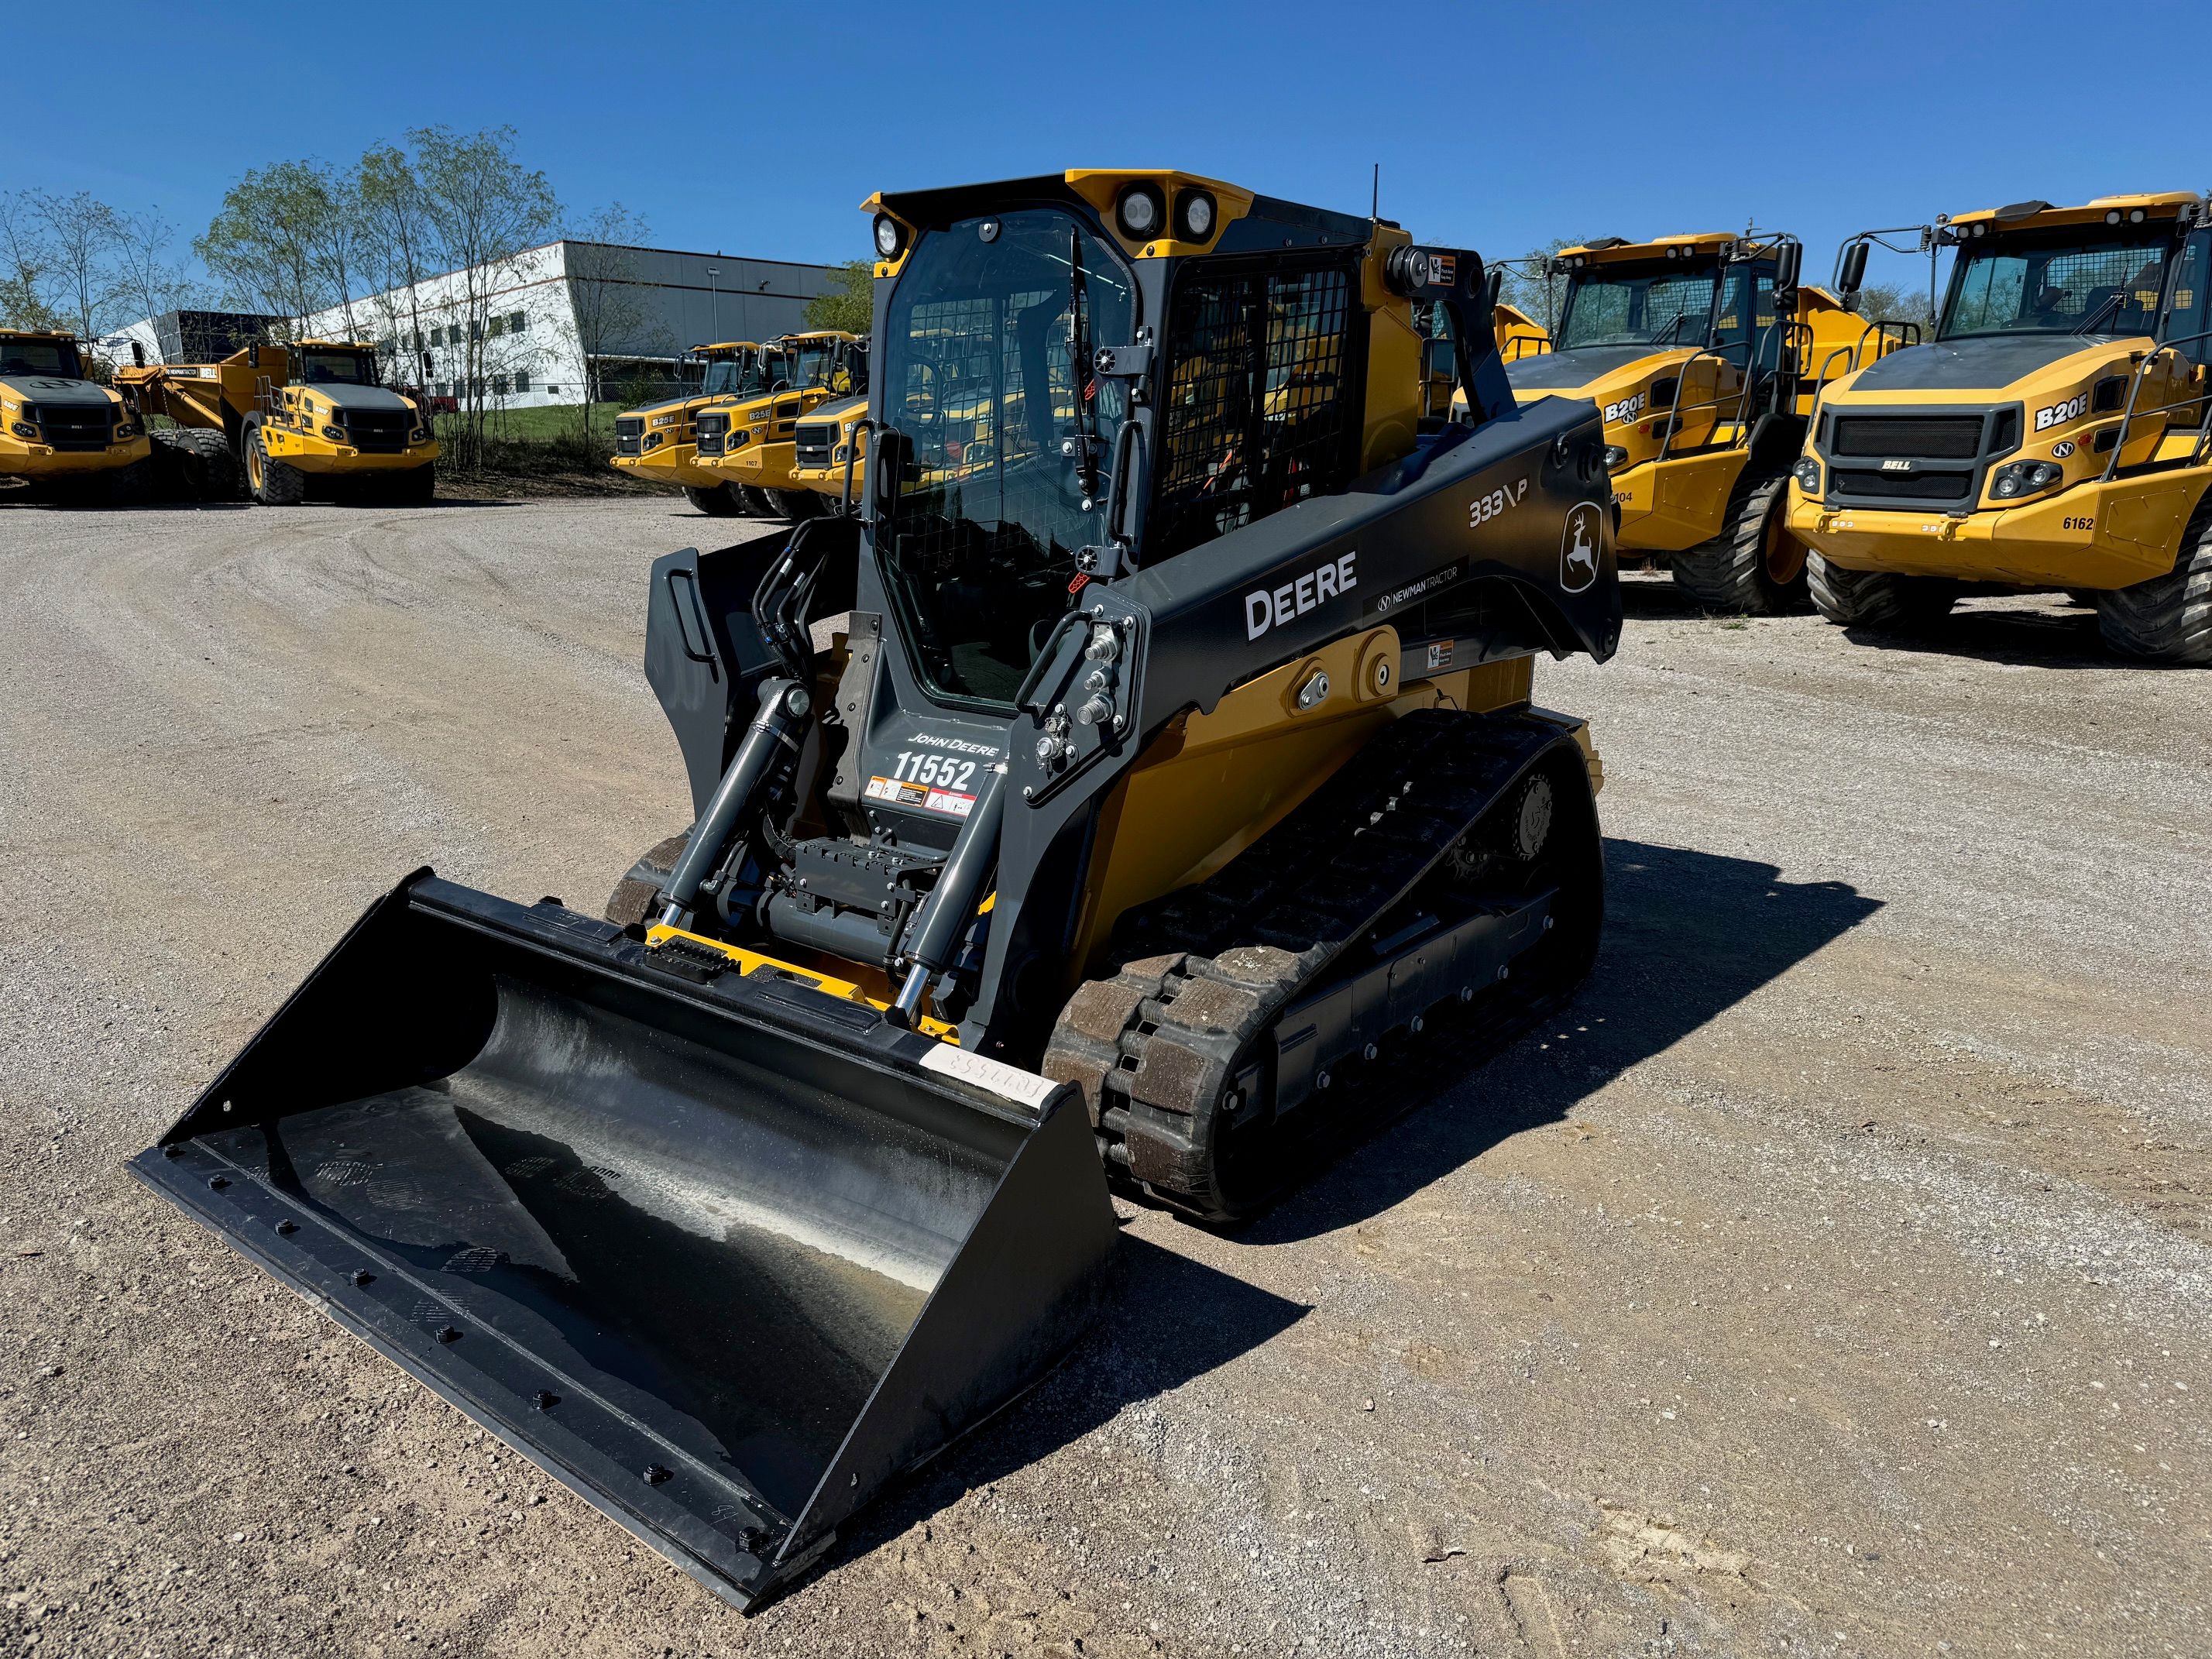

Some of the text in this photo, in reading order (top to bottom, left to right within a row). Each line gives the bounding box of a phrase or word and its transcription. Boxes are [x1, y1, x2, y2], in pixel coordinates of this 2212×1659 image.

[201, 367, 217, 379] BELL
[749, 409, 771, 421] B25E
[1605, 390, 1645, 423] B20E
[2035, 391, 2087, 432] B20E
[652, 414, 675, 427] B25E
[1881, 460, 1911, 470] BELL
[2063, 517, 2094, 530] 6162
[1245, 551, 1357, 641] DEERE
[908, 732, 1000, 757] JOHN DEERE
[893, 751, 976, 792] 11552
